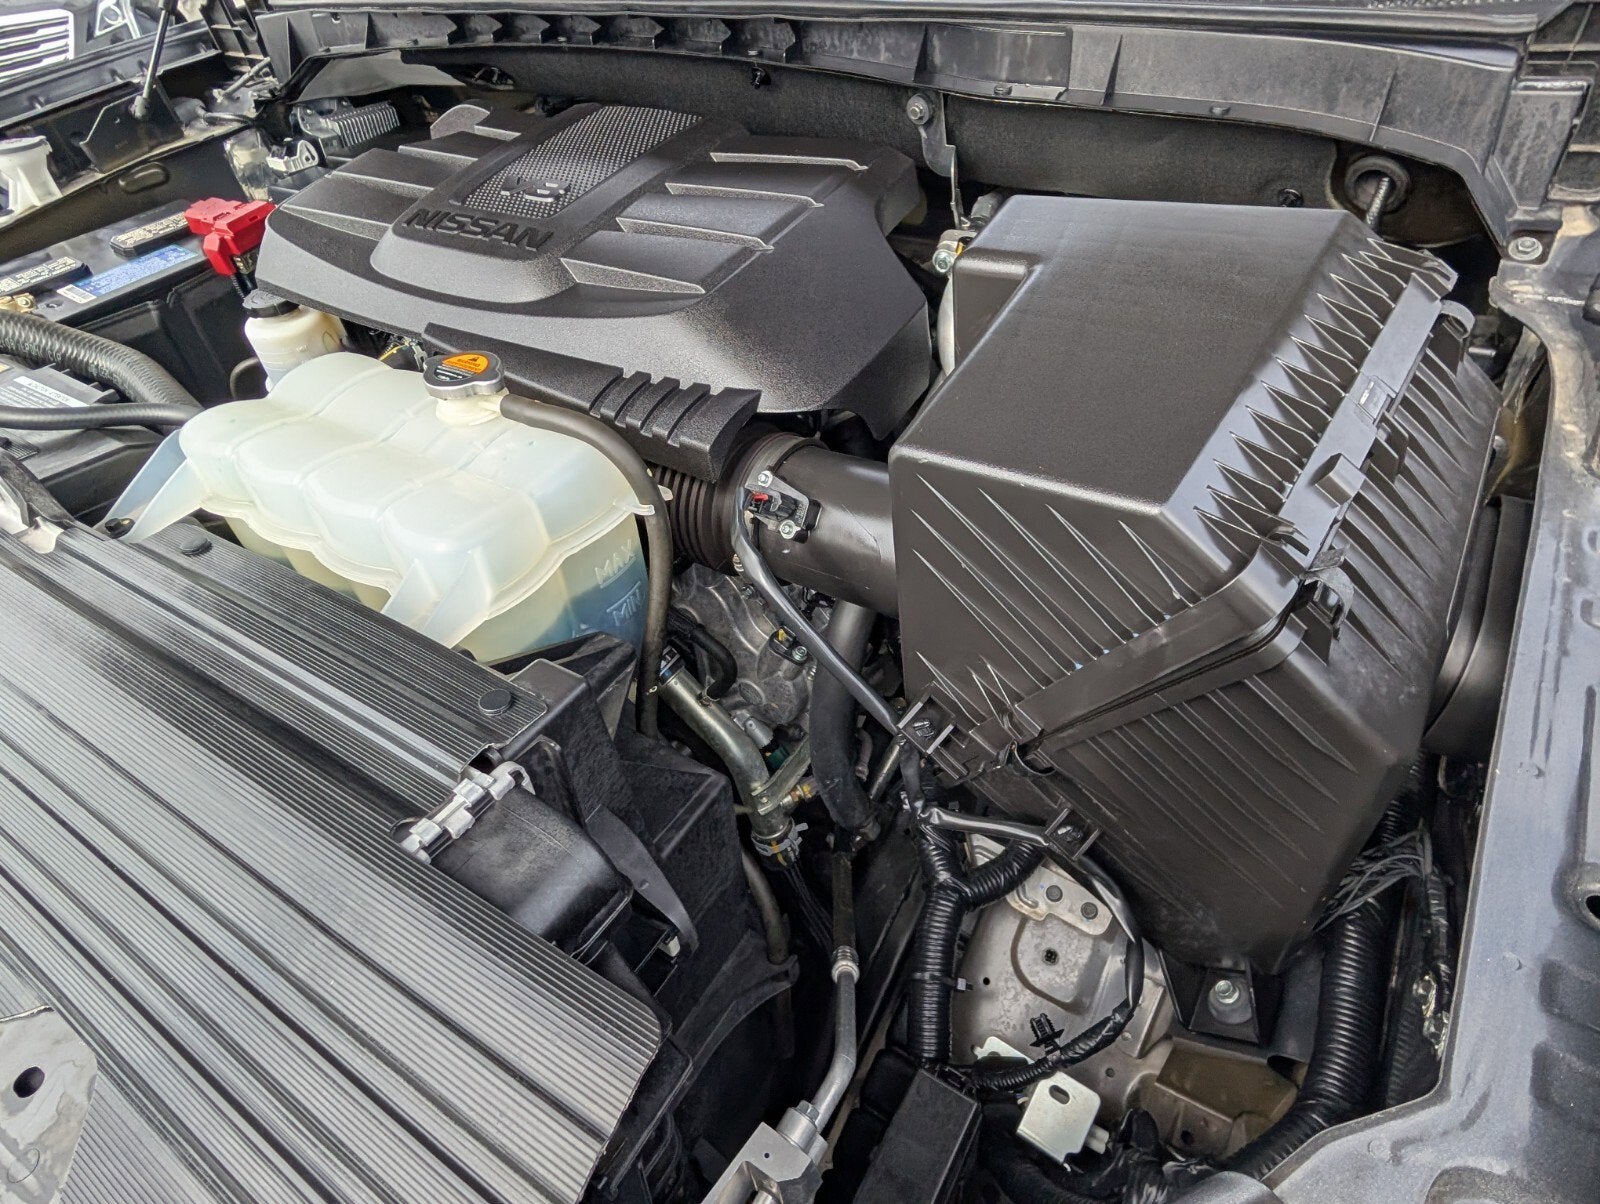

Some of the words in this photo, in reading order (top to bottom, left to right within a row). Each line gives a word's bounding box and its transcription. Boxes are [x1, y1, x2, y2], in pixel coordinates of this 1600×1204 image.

[500, 175, 571, 203] V8
[401, 208, 554, 251] NISSAN
[594, 538, 635, 584] MAX
[612, 588, 645, 626] MIN
